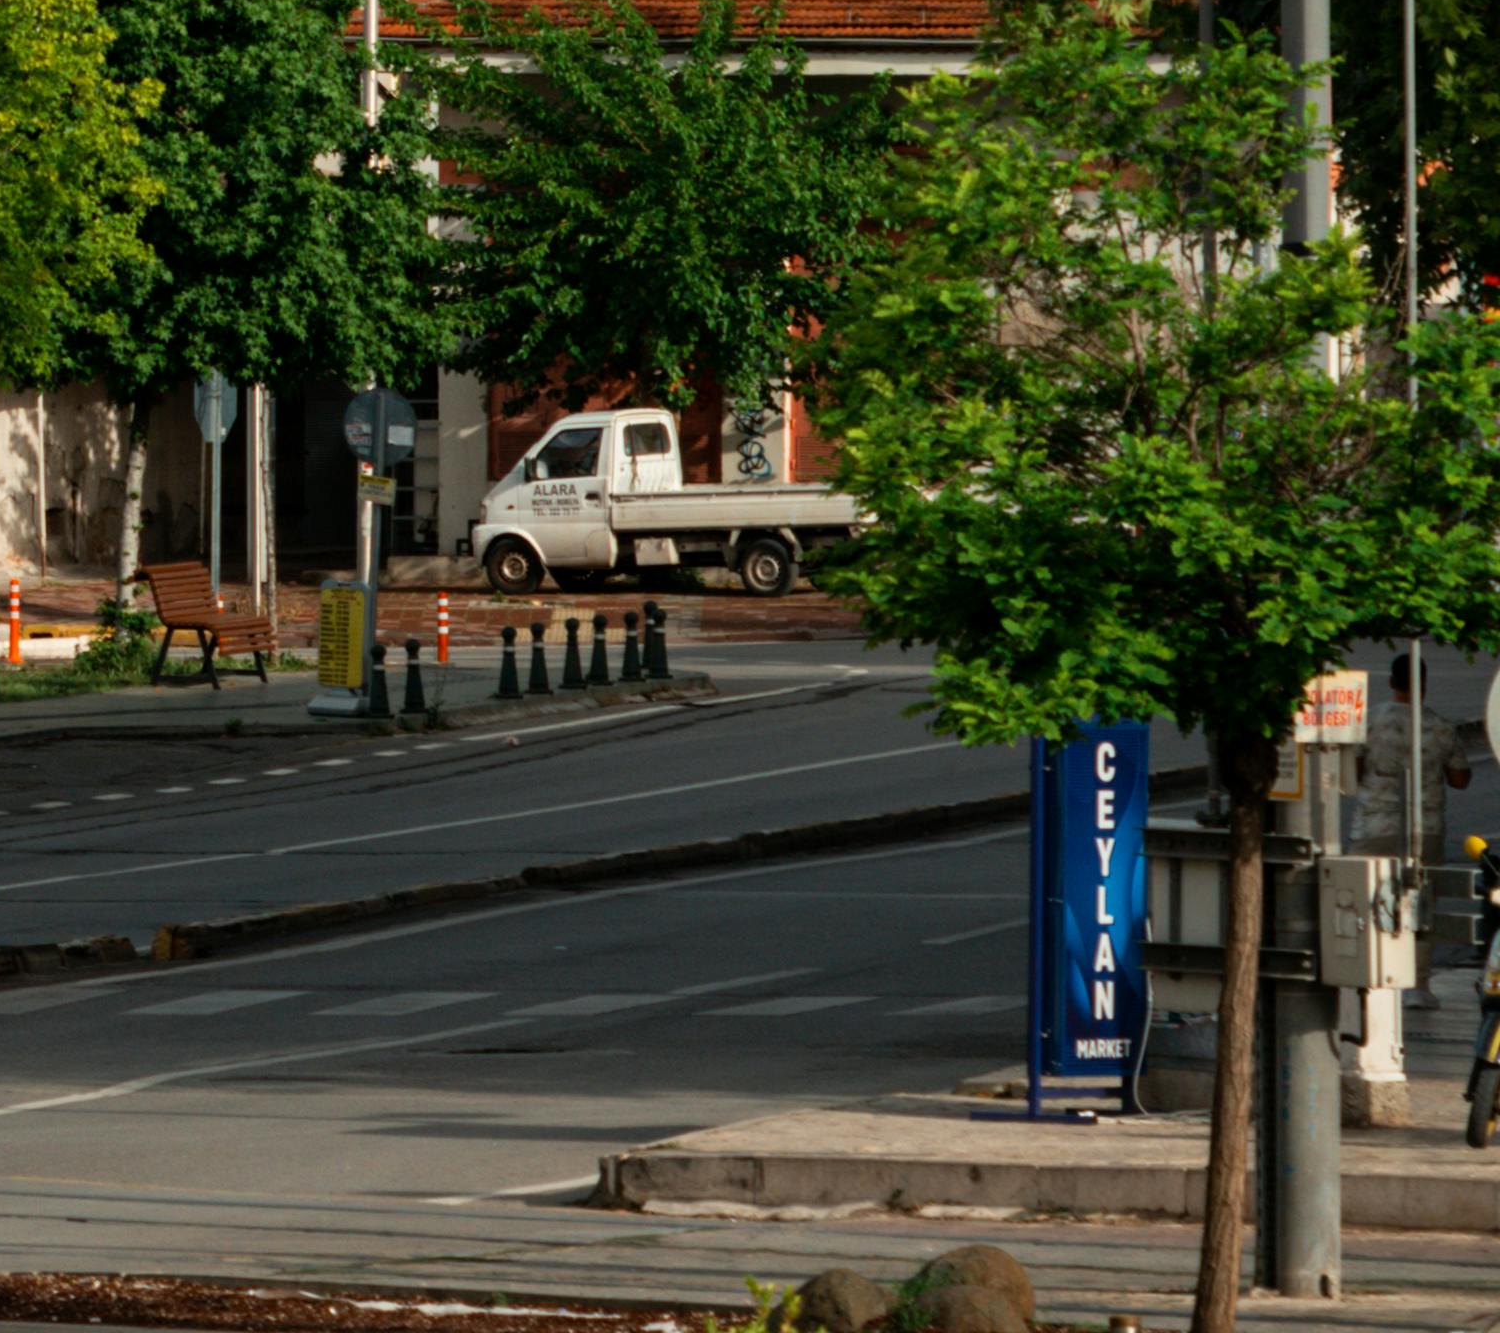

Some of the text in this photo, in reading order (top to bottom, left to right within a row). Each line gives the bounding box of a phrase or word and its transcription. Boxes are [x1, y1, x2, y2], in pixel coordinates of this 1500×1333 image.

[533, 484, 577, 496] ALARA
[1094, 741, 1117, 1021] CEYLAN
[1076, 1038, 1132, 1060] MARKET
